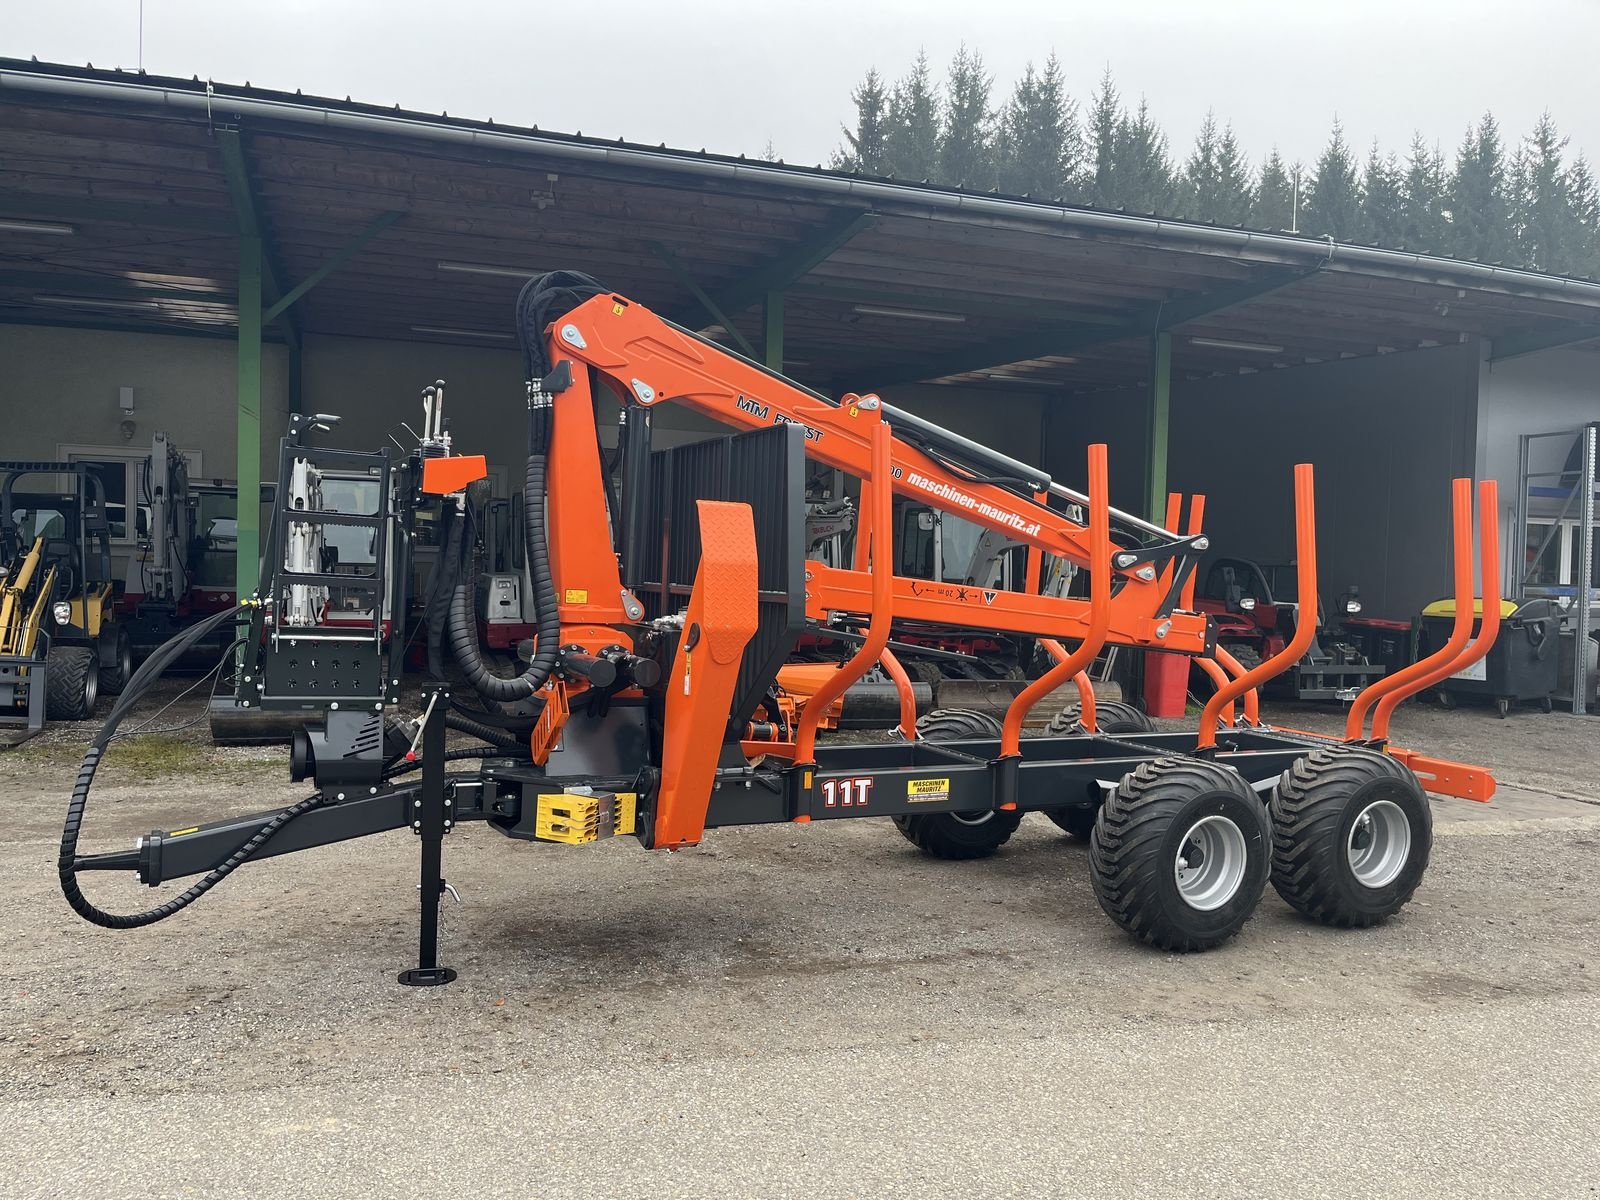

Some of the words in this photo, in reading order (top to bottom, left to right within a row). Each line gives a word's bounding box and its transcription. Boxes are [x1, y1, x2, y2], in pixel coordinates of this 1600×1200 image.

[736, 394, 769, 420] MTM
[907, 472, 1041, 537] maschinen-mauritz.at
[821, 776, 874, 807] 11T
